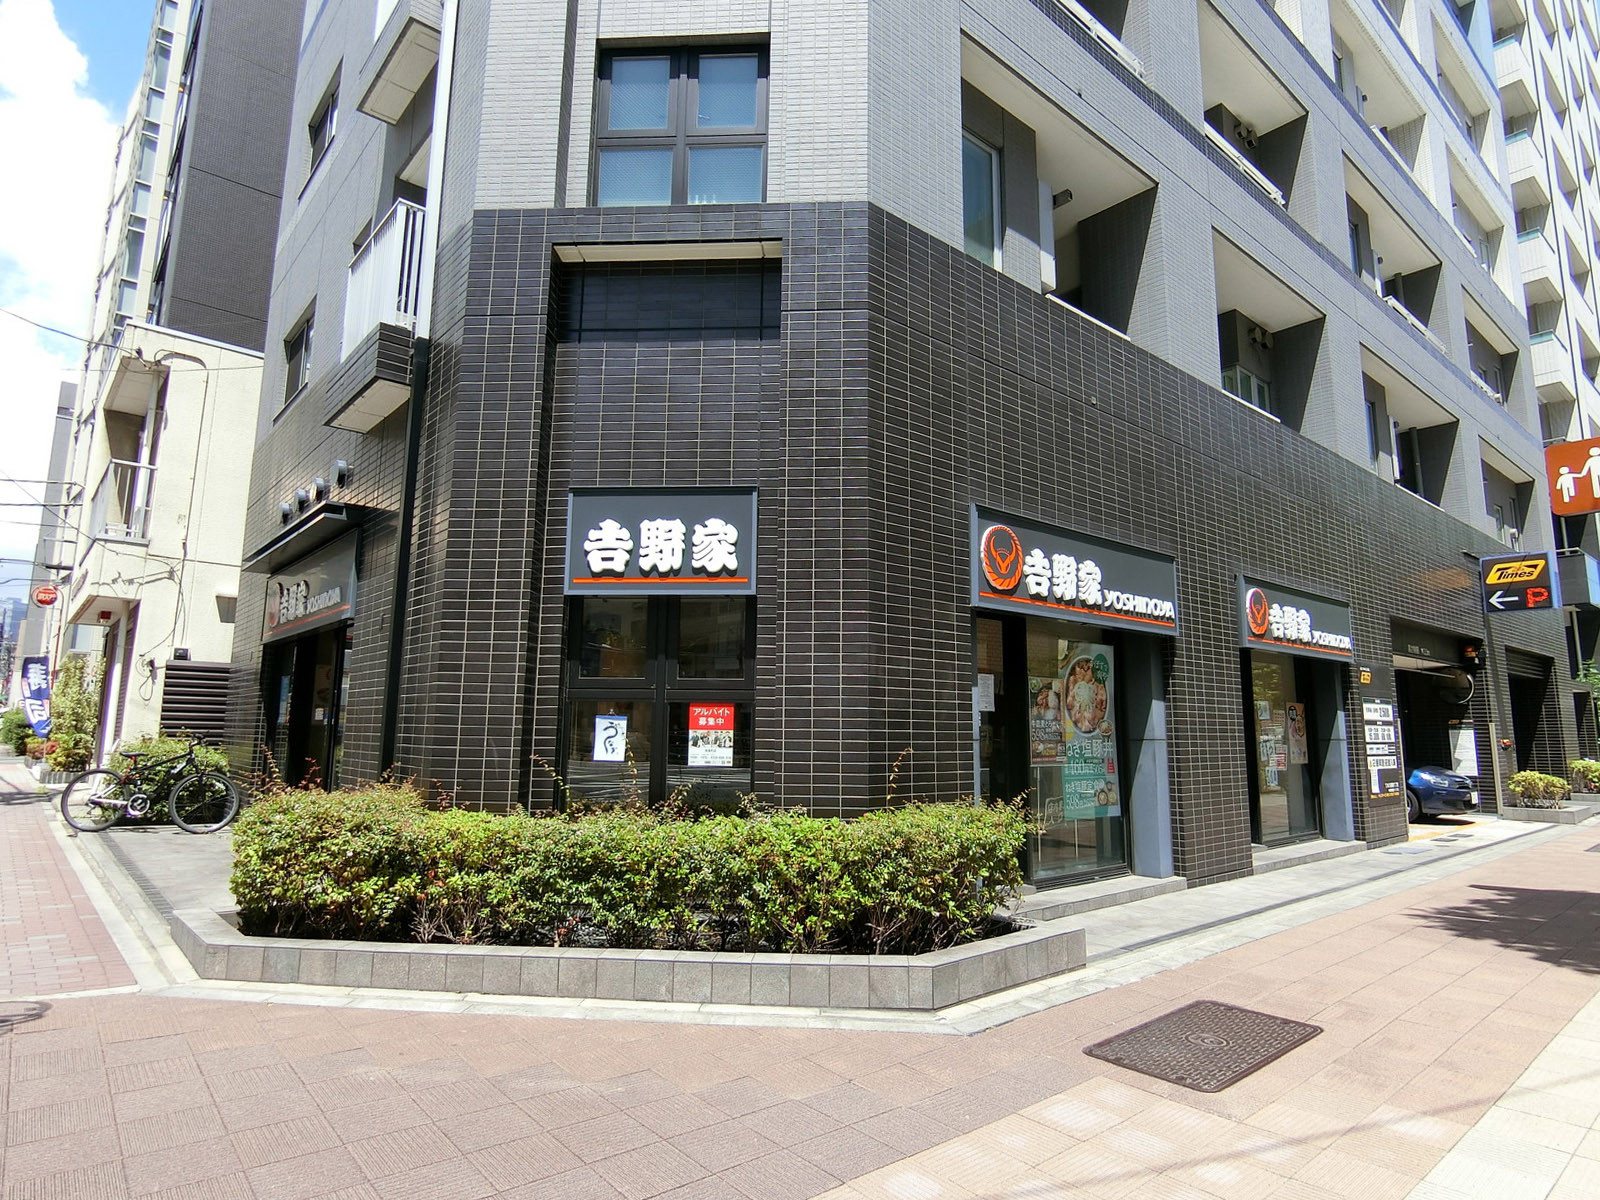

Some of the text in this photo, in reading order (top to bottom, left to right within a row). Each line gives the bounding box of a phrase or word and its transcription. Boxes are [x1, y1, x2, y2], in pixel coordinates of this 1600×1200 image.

[584, 518, 739, 574] 吉野家
[1023, 548, 1176, 619] 吉野家 YOSHINOYA
[1526, 587, 1549, 608] P
[1268, 603, 1313, 643] 吉野家
[693, 707, 731, 717] アルバイト
[698, 717, 725, 726] 募集中
